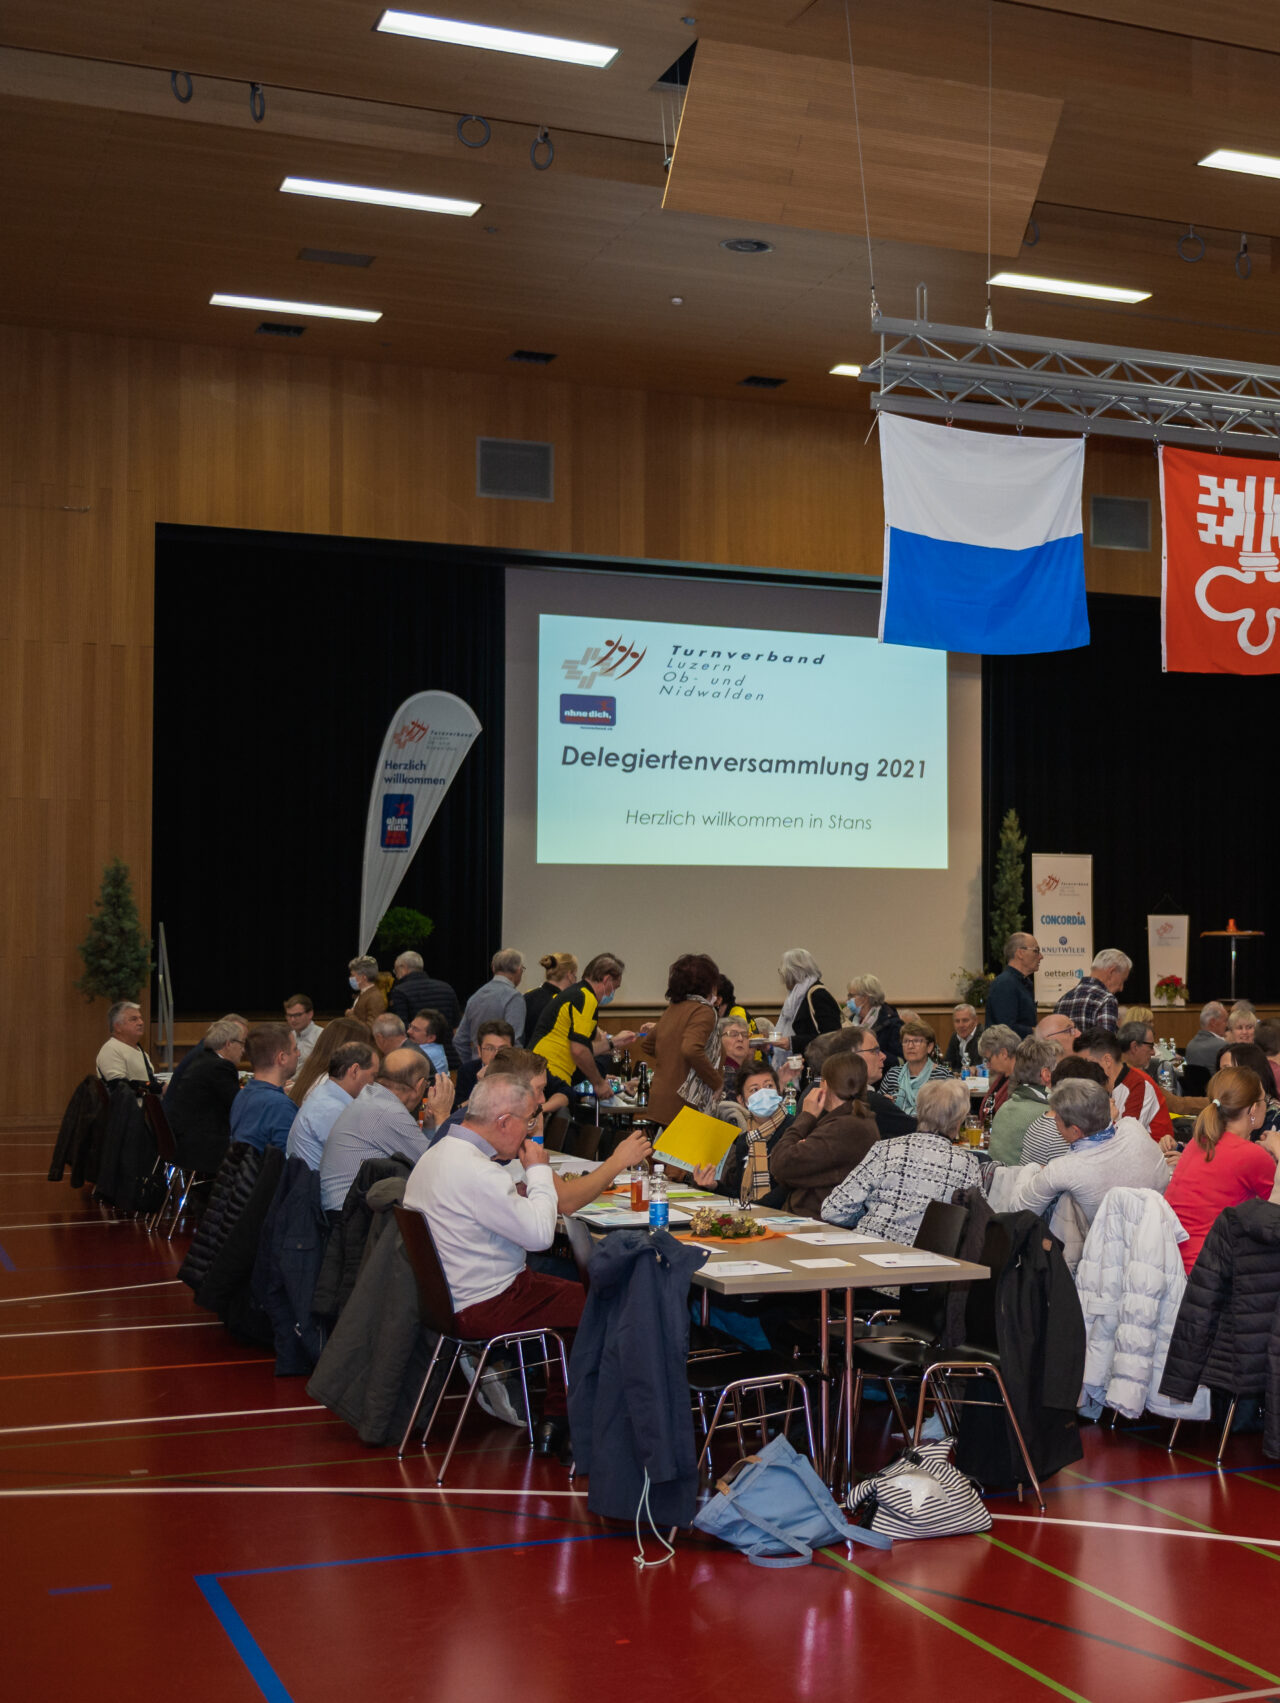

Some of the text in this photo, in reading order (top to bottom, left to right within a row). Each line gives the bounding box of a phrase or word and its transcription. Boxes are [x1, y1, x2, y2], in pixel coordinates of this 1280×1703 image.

[671, 644, 826, 666] Turnverband
[666, 658, 732, 673] Luzern
[663, 671, 747, 687] Ob- und
[659, 684, 766, 702] Nidwalden
[384, 759, 427, 772] Herzlich
[561, 745, 927, 781] Delegiertenversammlung 2021
[384, 773, 446, 786] willkommen
[625, 809, 872, 831] Herzlich willkommen in Stans
[1041, 912, 1086, 926] CONCORDIA
[1041, 946, 1086, 954] KNUTWILER
